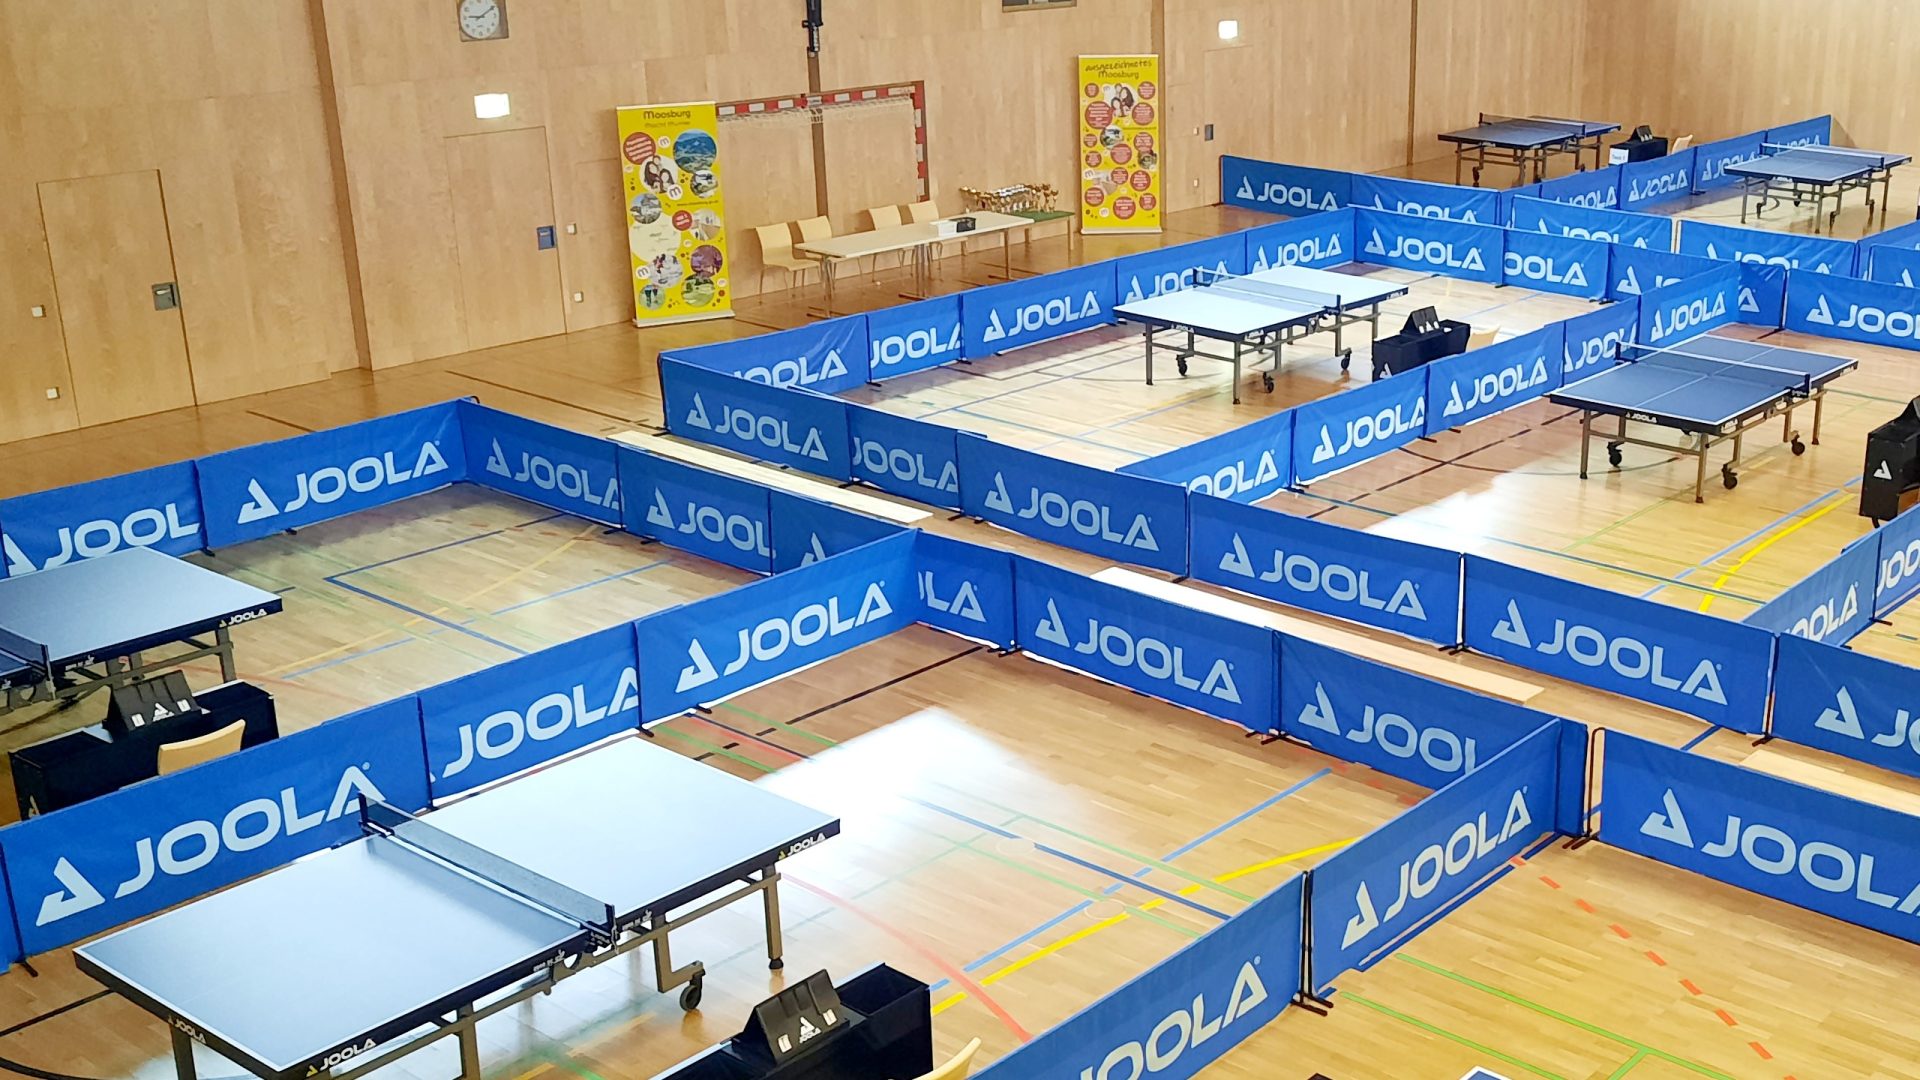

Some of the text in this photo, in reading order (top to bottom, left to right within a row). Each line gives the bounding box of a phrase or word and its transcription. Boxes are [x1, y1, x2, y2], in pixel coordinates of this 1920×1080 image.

[1098, 70, 1140, 80] Moosburg
[643, 110, 691, 120] Moosburg
[1257, 183, 1338, 211] JOOLA
[1640, 168, 1689, 200] JOOLA
[1273, 234, 1342, 269] JOOLA
[1388, 238, 1486, 271] JOOLA
[1504, 252, 1589, 287] OOLA
[1007, 291, 1101, 335] JOOLA
[1665, 292, 1726, 337] JOOLA
[1837, 304, 1920, 340] JOO
[734, 349, 848, 389] OOLA
[1467, 358, 1547, 411] JOOLA
[715, 404, 829, 462] JOOLA
[1337, 396, 1425, 457] JOOLA
[1632, 413, 1657, 424] JOOLA
[284, 441, 448, 512] JOOLA
[1182, 450, 1279, 499] OOLA
[43, 503, 199, 568] JOOL
[678, 502, 776, 558] JOOL
[1017, 486, 1160, 552] JOOLA
[1259, 549, 1428, 621] JOOLA
[1876, 539, 1920, 598] JOO
[228, 608, 267, 625] JOOLA
[723, 581, 893, 676] JOOLA
[1785, 584, 1858, 642] OOLA
[1075, 618, 1242, 704] JOOLA
[1536, 619, 1729, 705] JOOLA
[443, 666, 639, 779] JOOLA
[1345, 705, 1476, 774] JOOL
[114, 765, 386, 899] JOOLA
[787, 832, 826, 856] JOOLA
[1383, 788, 1532, 922] JOOLA
[1701, 815, 1920, 916] JOOL
[174, 1017, 207, 1044] JOOLA
[1080, 961, 1268, 1080] OOLA
[319, 1037, 376, 1072] JOOLA
